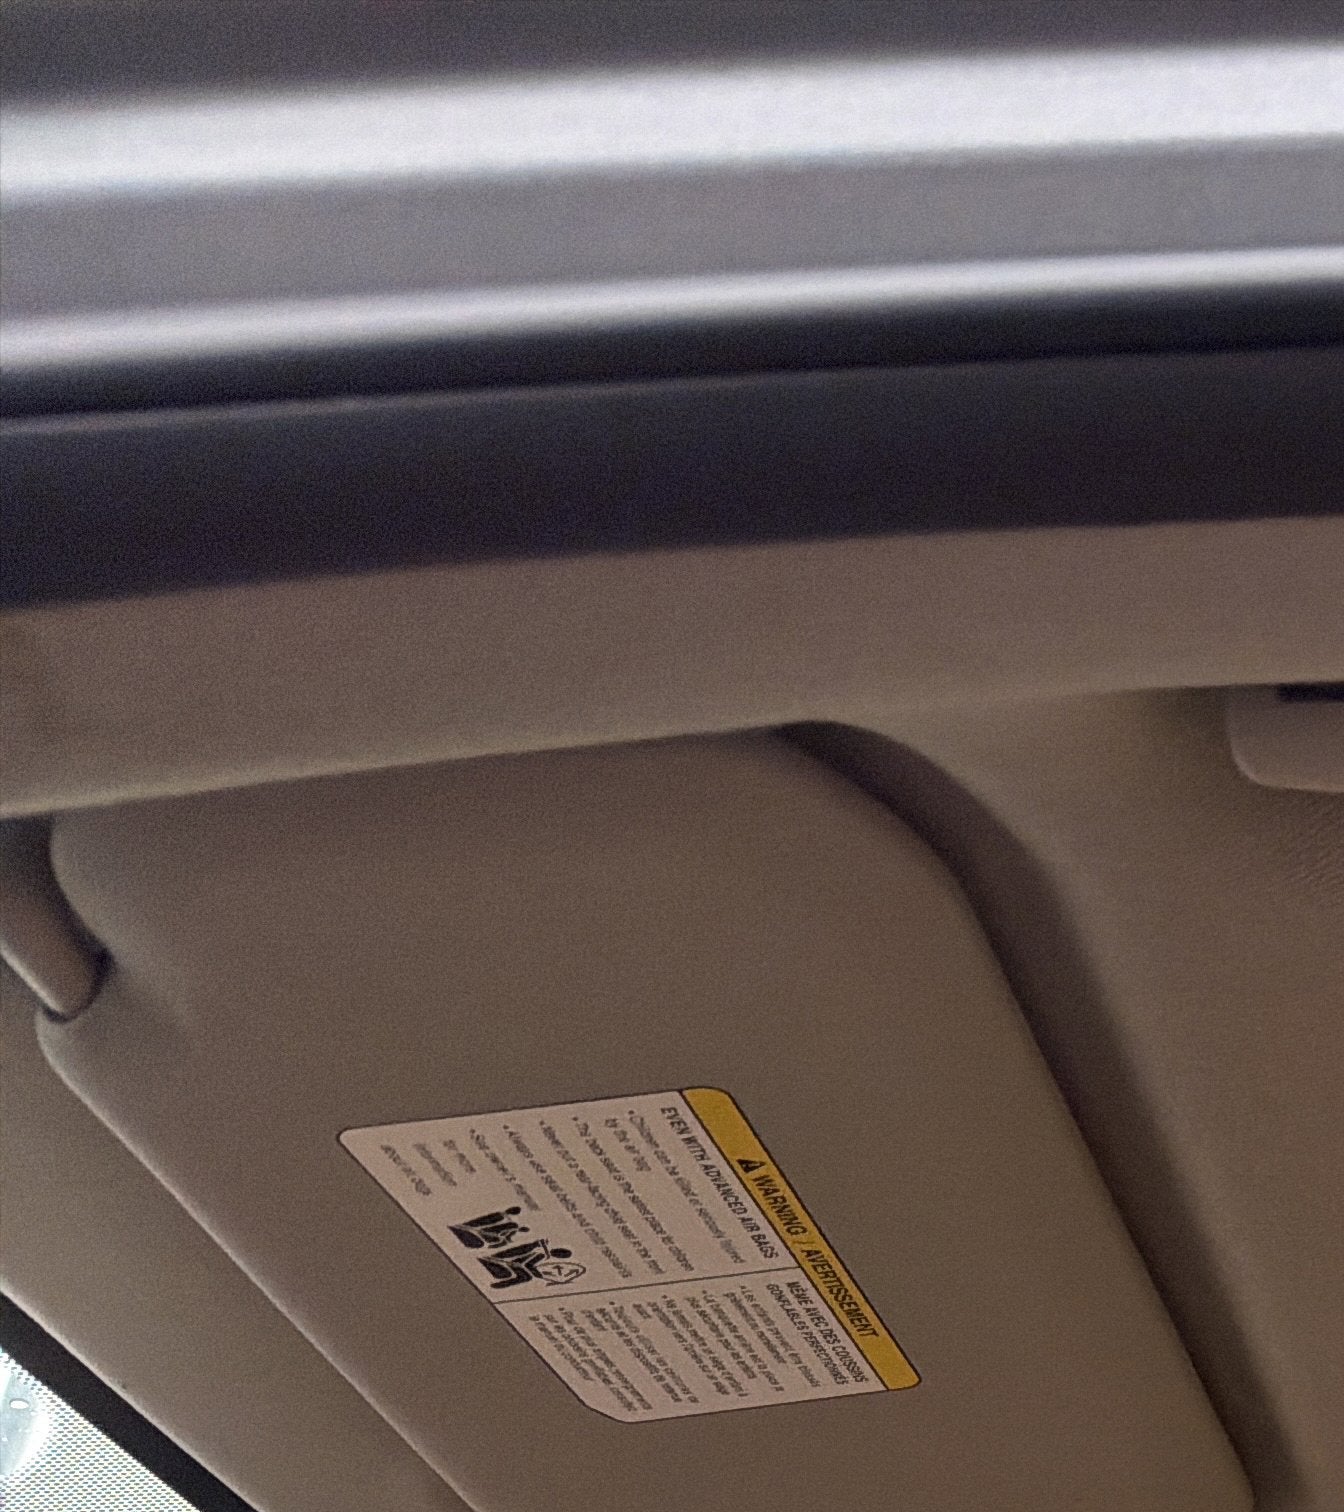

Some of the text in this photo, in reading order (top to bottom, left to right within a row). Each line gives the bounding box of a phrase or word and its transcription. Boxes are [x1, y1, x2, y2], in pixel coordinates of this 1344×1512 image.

[661, 1107, 778, 1258] EVEN WITH ADVANCED AIR BAGS
[753, 1175, 807, 1235] WARNING
[801, 1250, 879, 1336] AVERTISSEMENT
[766, 1284, 809, 1330] GONFLABLES
[805, 1308, 828, 1327] AVEC
[820, 1329, 840, 1344] DES
[832, 1346, 868, 1382] COUSSINS
